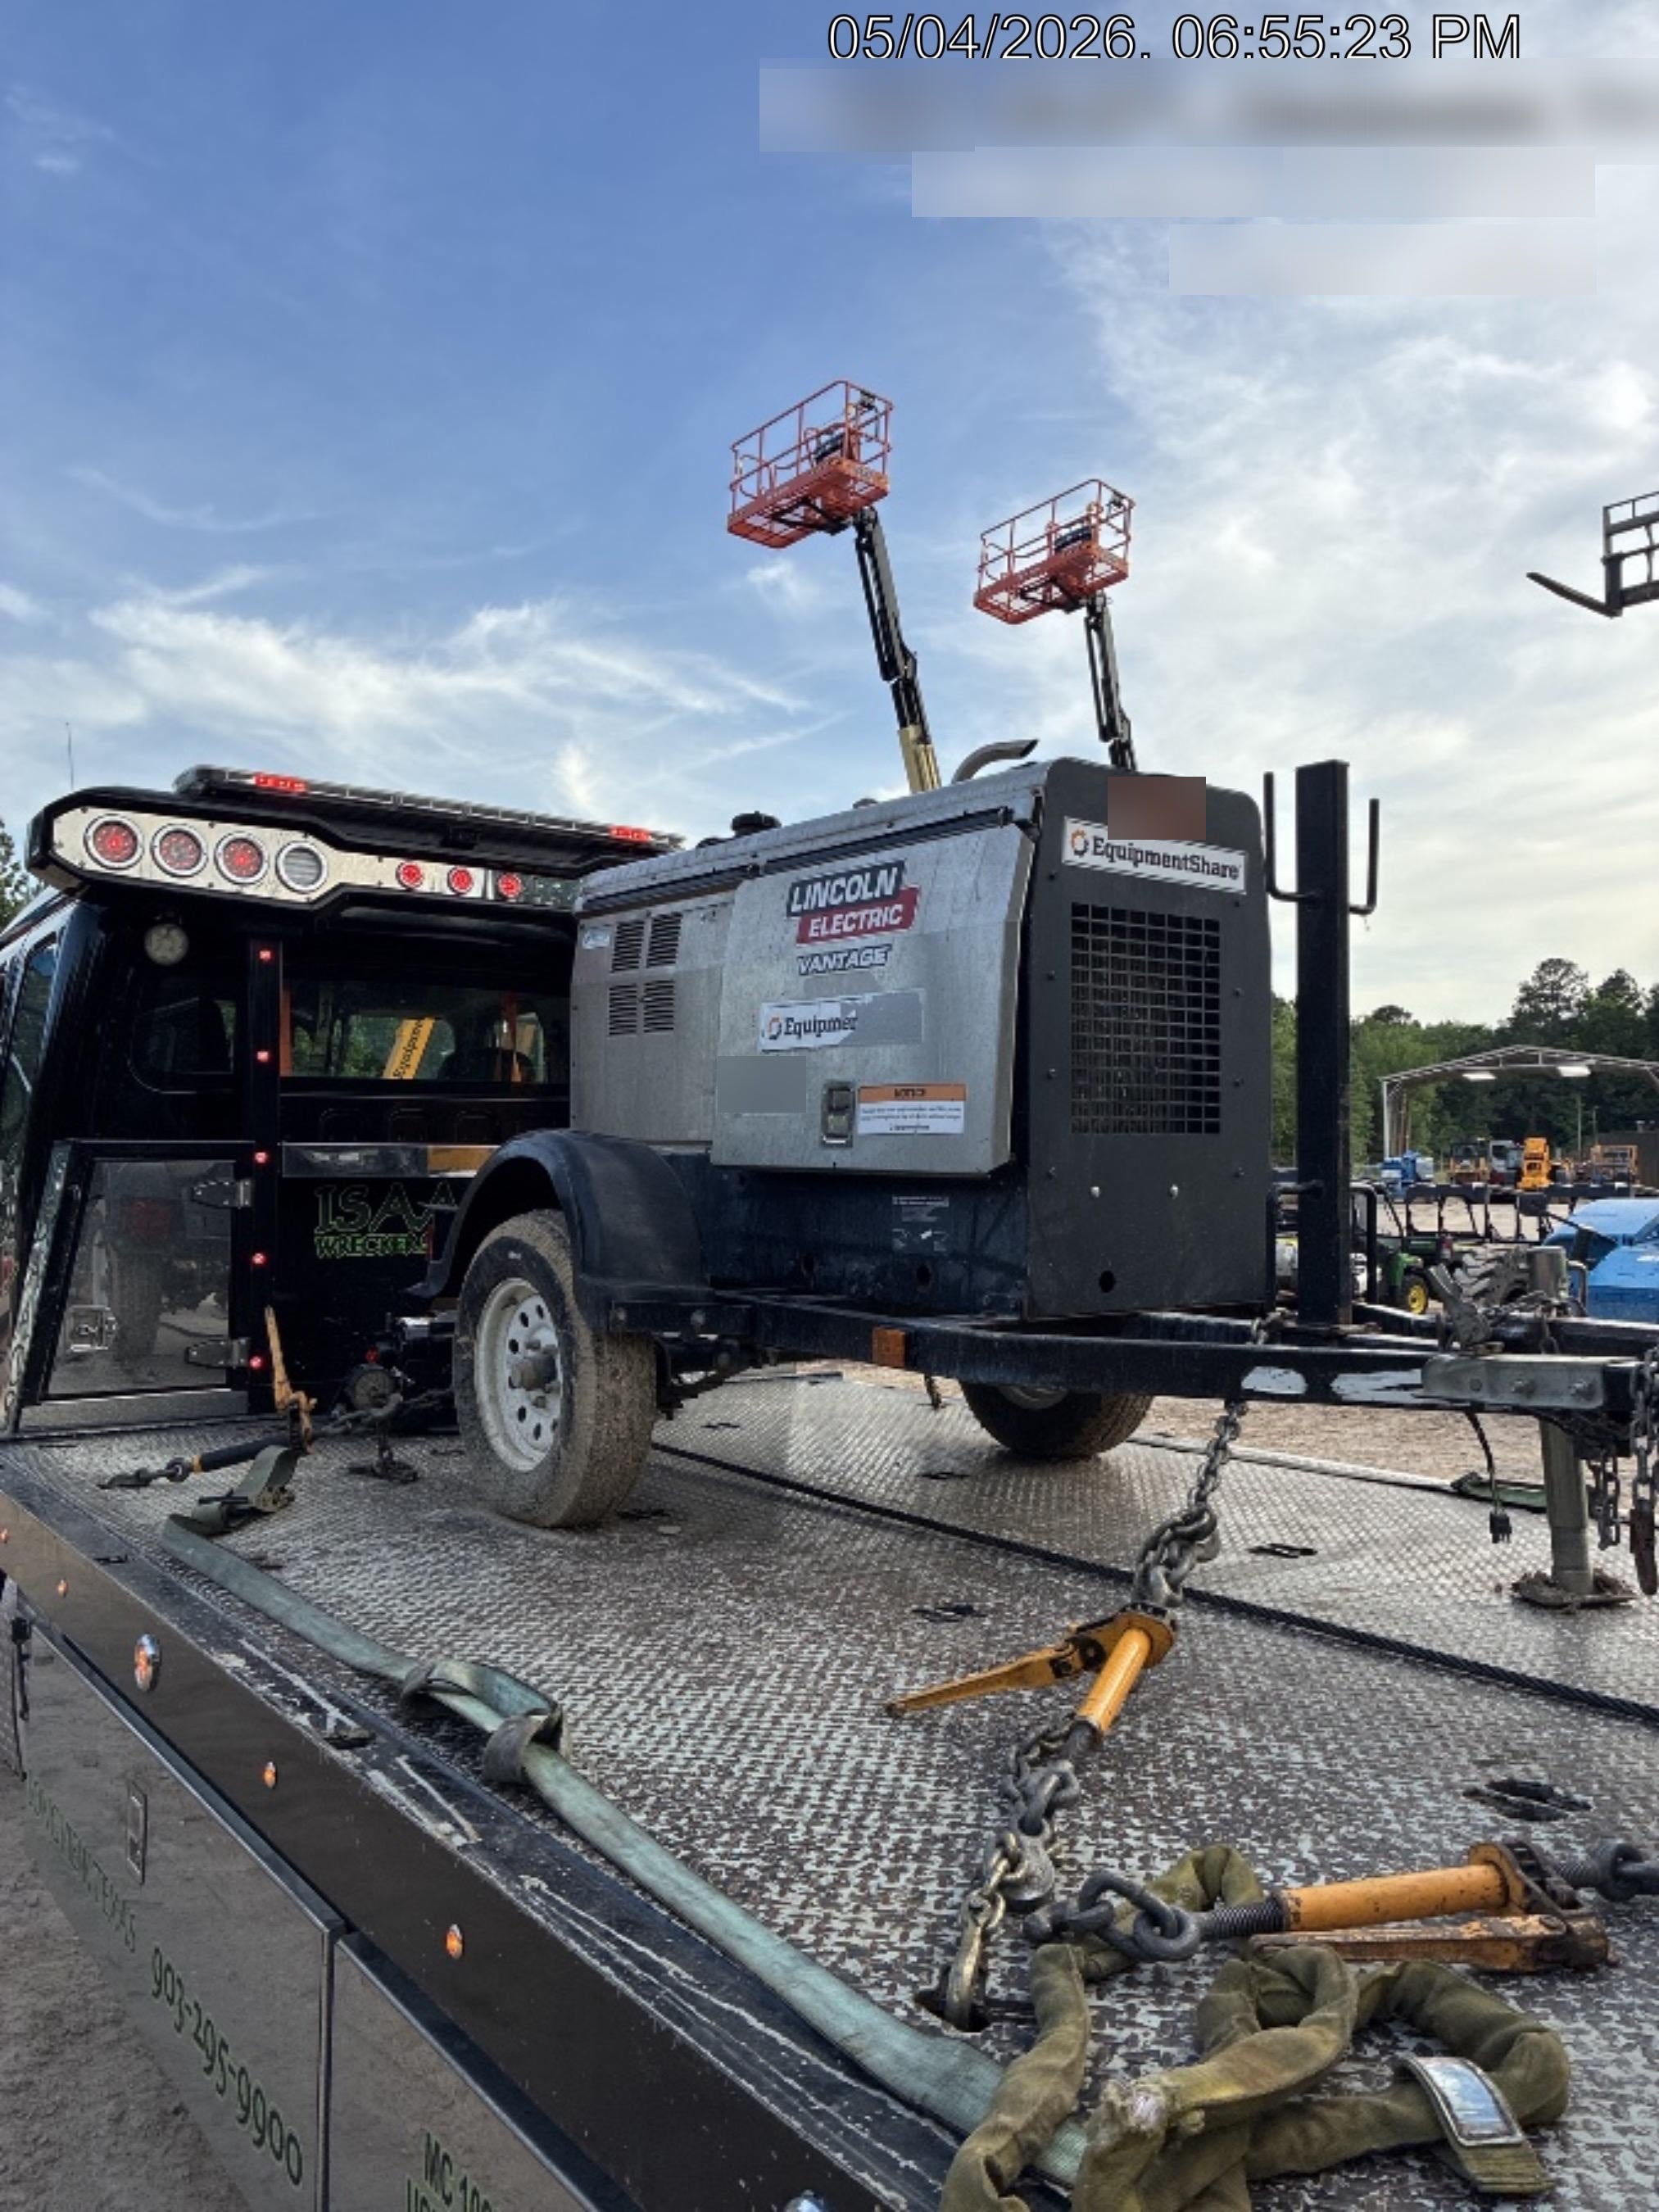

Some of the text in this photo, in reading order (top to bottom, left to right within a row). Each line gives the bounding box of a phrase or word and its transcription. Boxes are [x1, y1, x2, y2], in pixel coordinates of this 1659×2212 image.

[1091, 834, 1241, 881] EquipmentShare
[790, 866, 900, 913] LINCOLN
[808, 904, 904, 938] ELECTRIC
[797, 944, 891, 976] VANTAGE
[151, 1946, 303, 2187] 903-295-9900
[424, 2132, 453, 2207] MC
